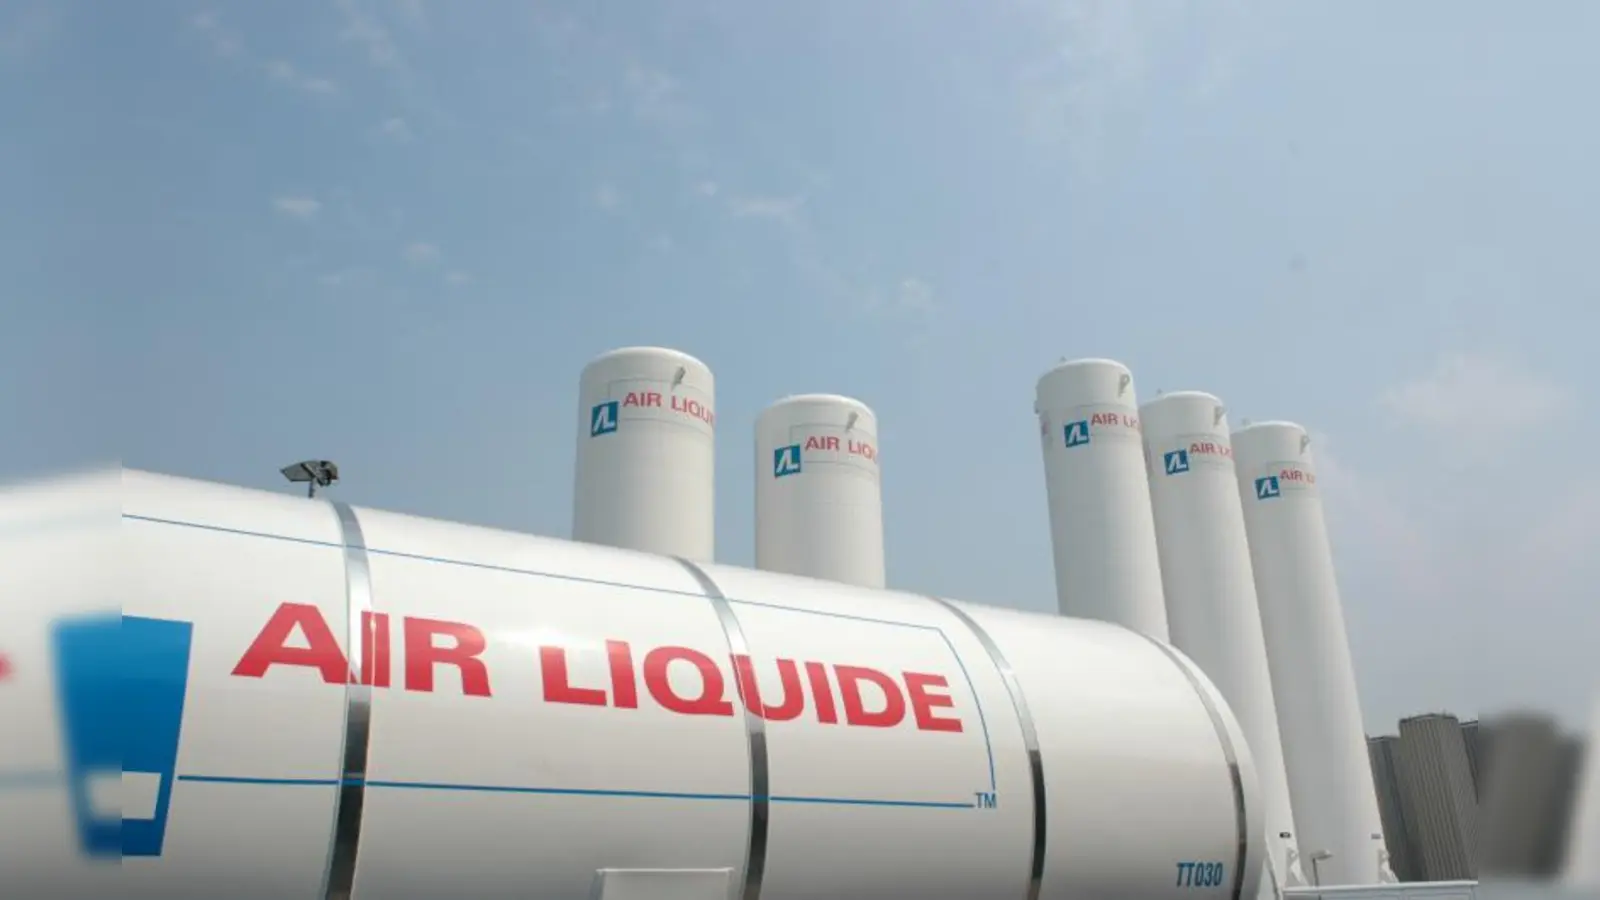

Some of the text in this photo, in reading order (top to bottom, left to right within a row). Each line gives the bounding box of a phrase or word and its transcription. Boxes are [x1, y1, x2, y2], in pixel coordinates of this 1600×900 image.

[623, 392, 662, 407] AIR
[1091, 412, 1118, 426] AIR
[805, 436, 840, 451] AIR
[1190, 442, 1214, 454] AIR
[1280, 469, 1302, 481] AIR
[231, 602, 963, 733] AIR LIQUIDE
[975, 792, 996, 809] TM
